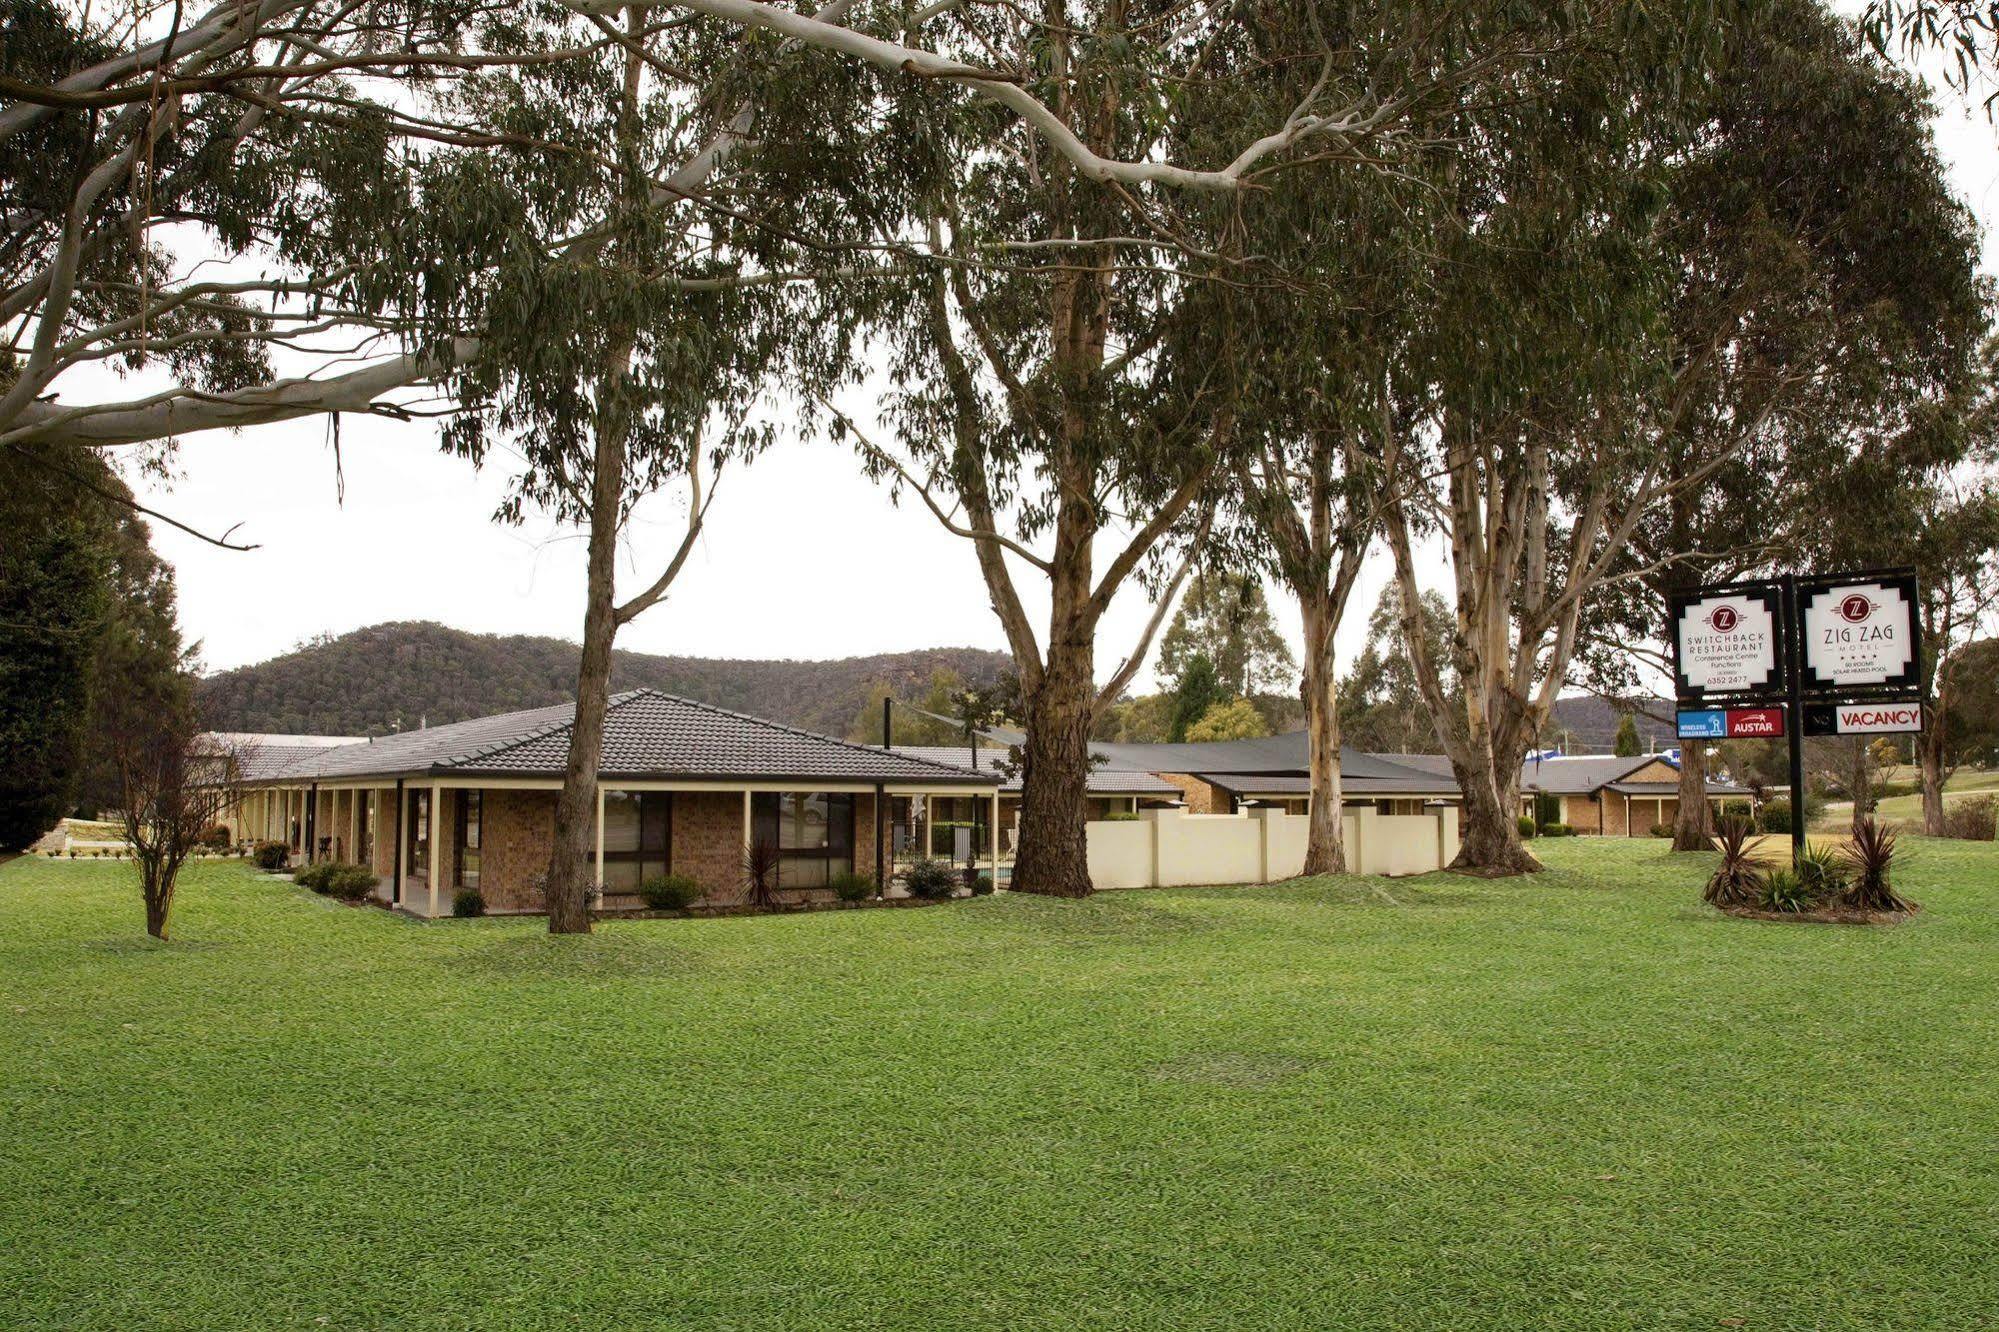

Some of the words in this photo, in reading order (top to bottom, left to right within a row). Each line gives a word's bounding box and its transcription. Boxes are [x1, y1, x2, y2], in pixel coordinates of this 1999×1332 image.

[1687, 633, 1764, 645] SWITCHBACK
[1824, 627, 1851, 644] ZIG
[1859, 624, 1894, 642] ZAG
[1689, 642, 1763, 654] RESTAURANT
[1840, 644, 1878, 652] MOTEL
[1694, 654, 1734, 662] Conference
[1711, 661, 1742, 669] Functions
[1871, 665, 1888, 673] POOL
[1707, 676, 1726, 685] 6352
[1728, 675, 1748, 684] 2477
[1842, 710, 1919, 726] VACANCY
[1734, 722, 1773, 733] AUSTAR
